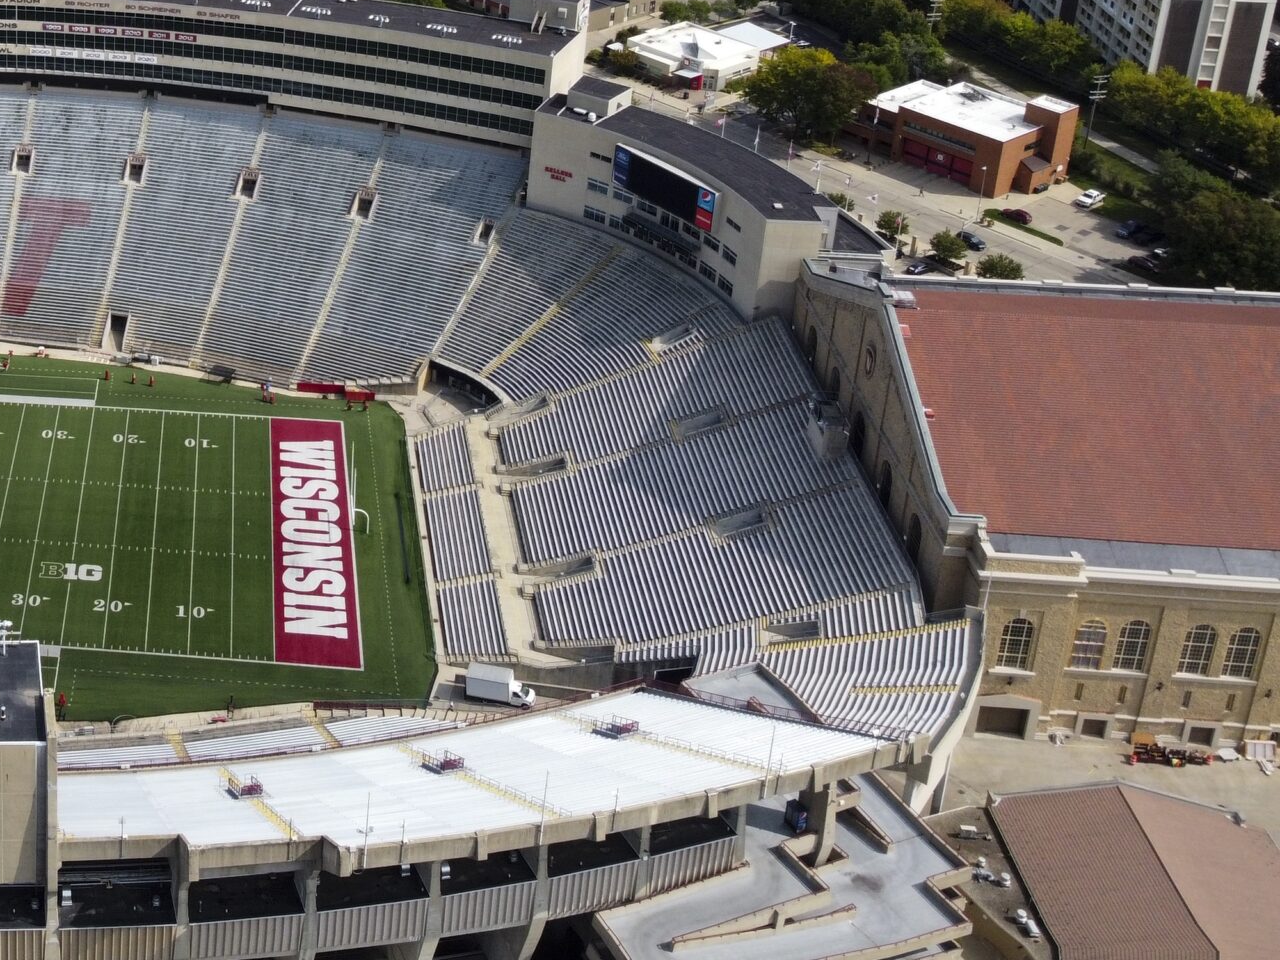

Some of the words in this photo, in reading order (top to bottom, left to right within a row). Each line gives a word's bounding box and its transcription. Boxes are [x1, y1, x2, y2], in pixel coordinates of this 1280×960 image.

[138, 5, 181, 14] SCHREINER
[209, 12, 240, 20] SHAFER
[41, 429, 69, 440] 30
[112, 433, 139, 444] 20
[184, 438, 211, 449] 10
[279, 439, 349, 640] WISCONSIN
[11, 593, 42, 607] 30
[92, 598, 123, 613] 20
[175, 604, 206, 619] 10
